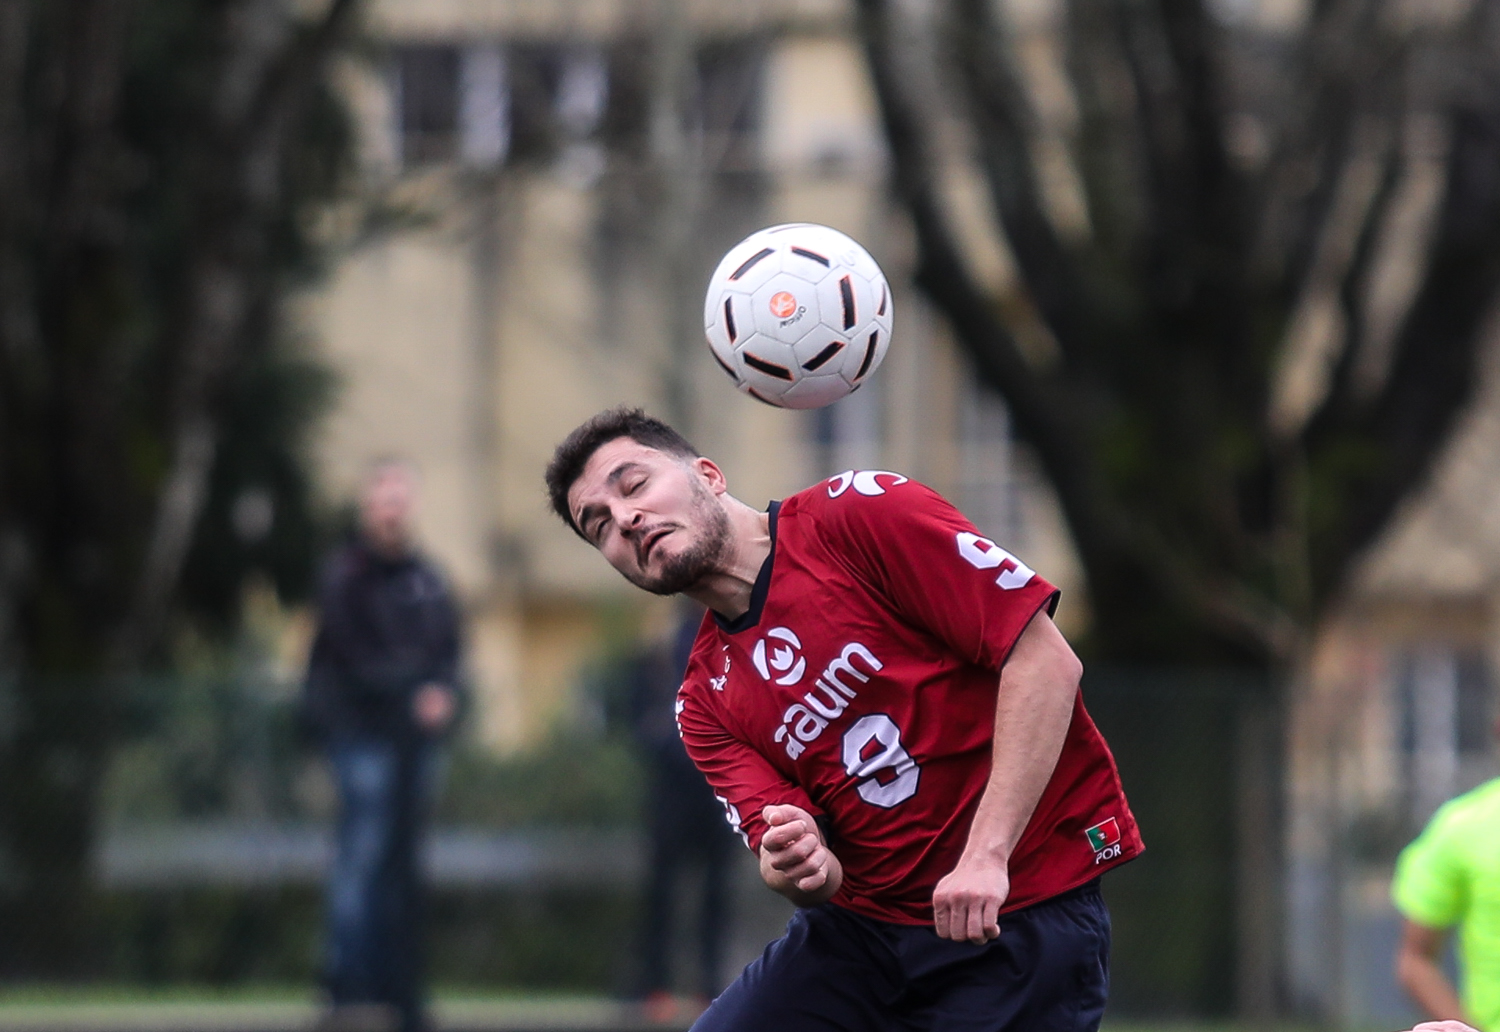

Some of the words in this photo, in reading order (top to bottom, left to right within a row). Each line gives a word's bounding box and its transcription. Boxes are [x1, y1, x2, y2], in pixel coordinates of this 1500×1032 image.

[956, 531, 1036, 590] 9
[842, 714, 921, 808] 9
[1095, 843, 1122, 865] POR
